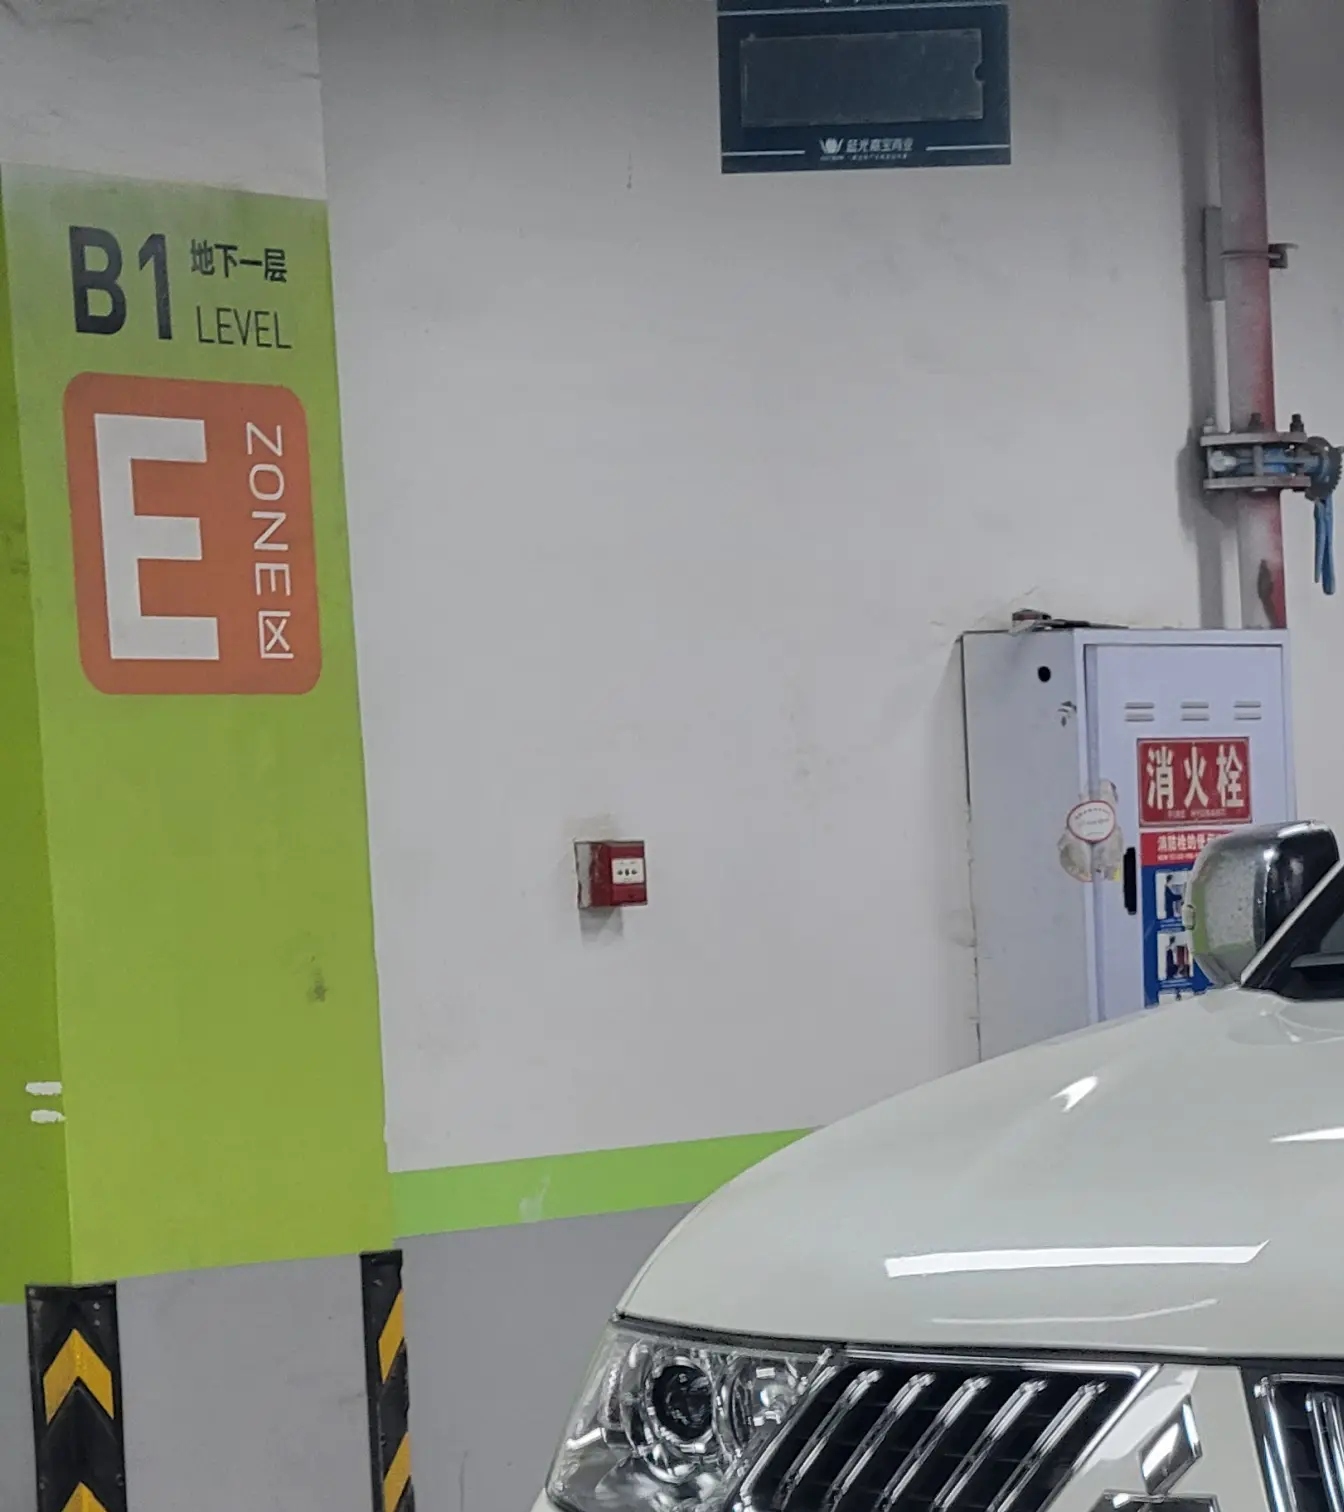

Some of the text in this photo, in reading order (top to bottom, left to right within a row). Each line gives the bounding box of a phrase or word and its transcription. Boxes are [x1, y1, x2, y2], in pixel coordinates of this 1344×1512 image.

[69, 226, 172, 340] B1
[190, 240, 287, 283] 地下一层
[195, 305, 293, 350] LEVEL
[94, 412, 220, 661] E
[246, 421, 295, 660] ZONE 区
[1146, 745, 1244, 810] 消火栓
